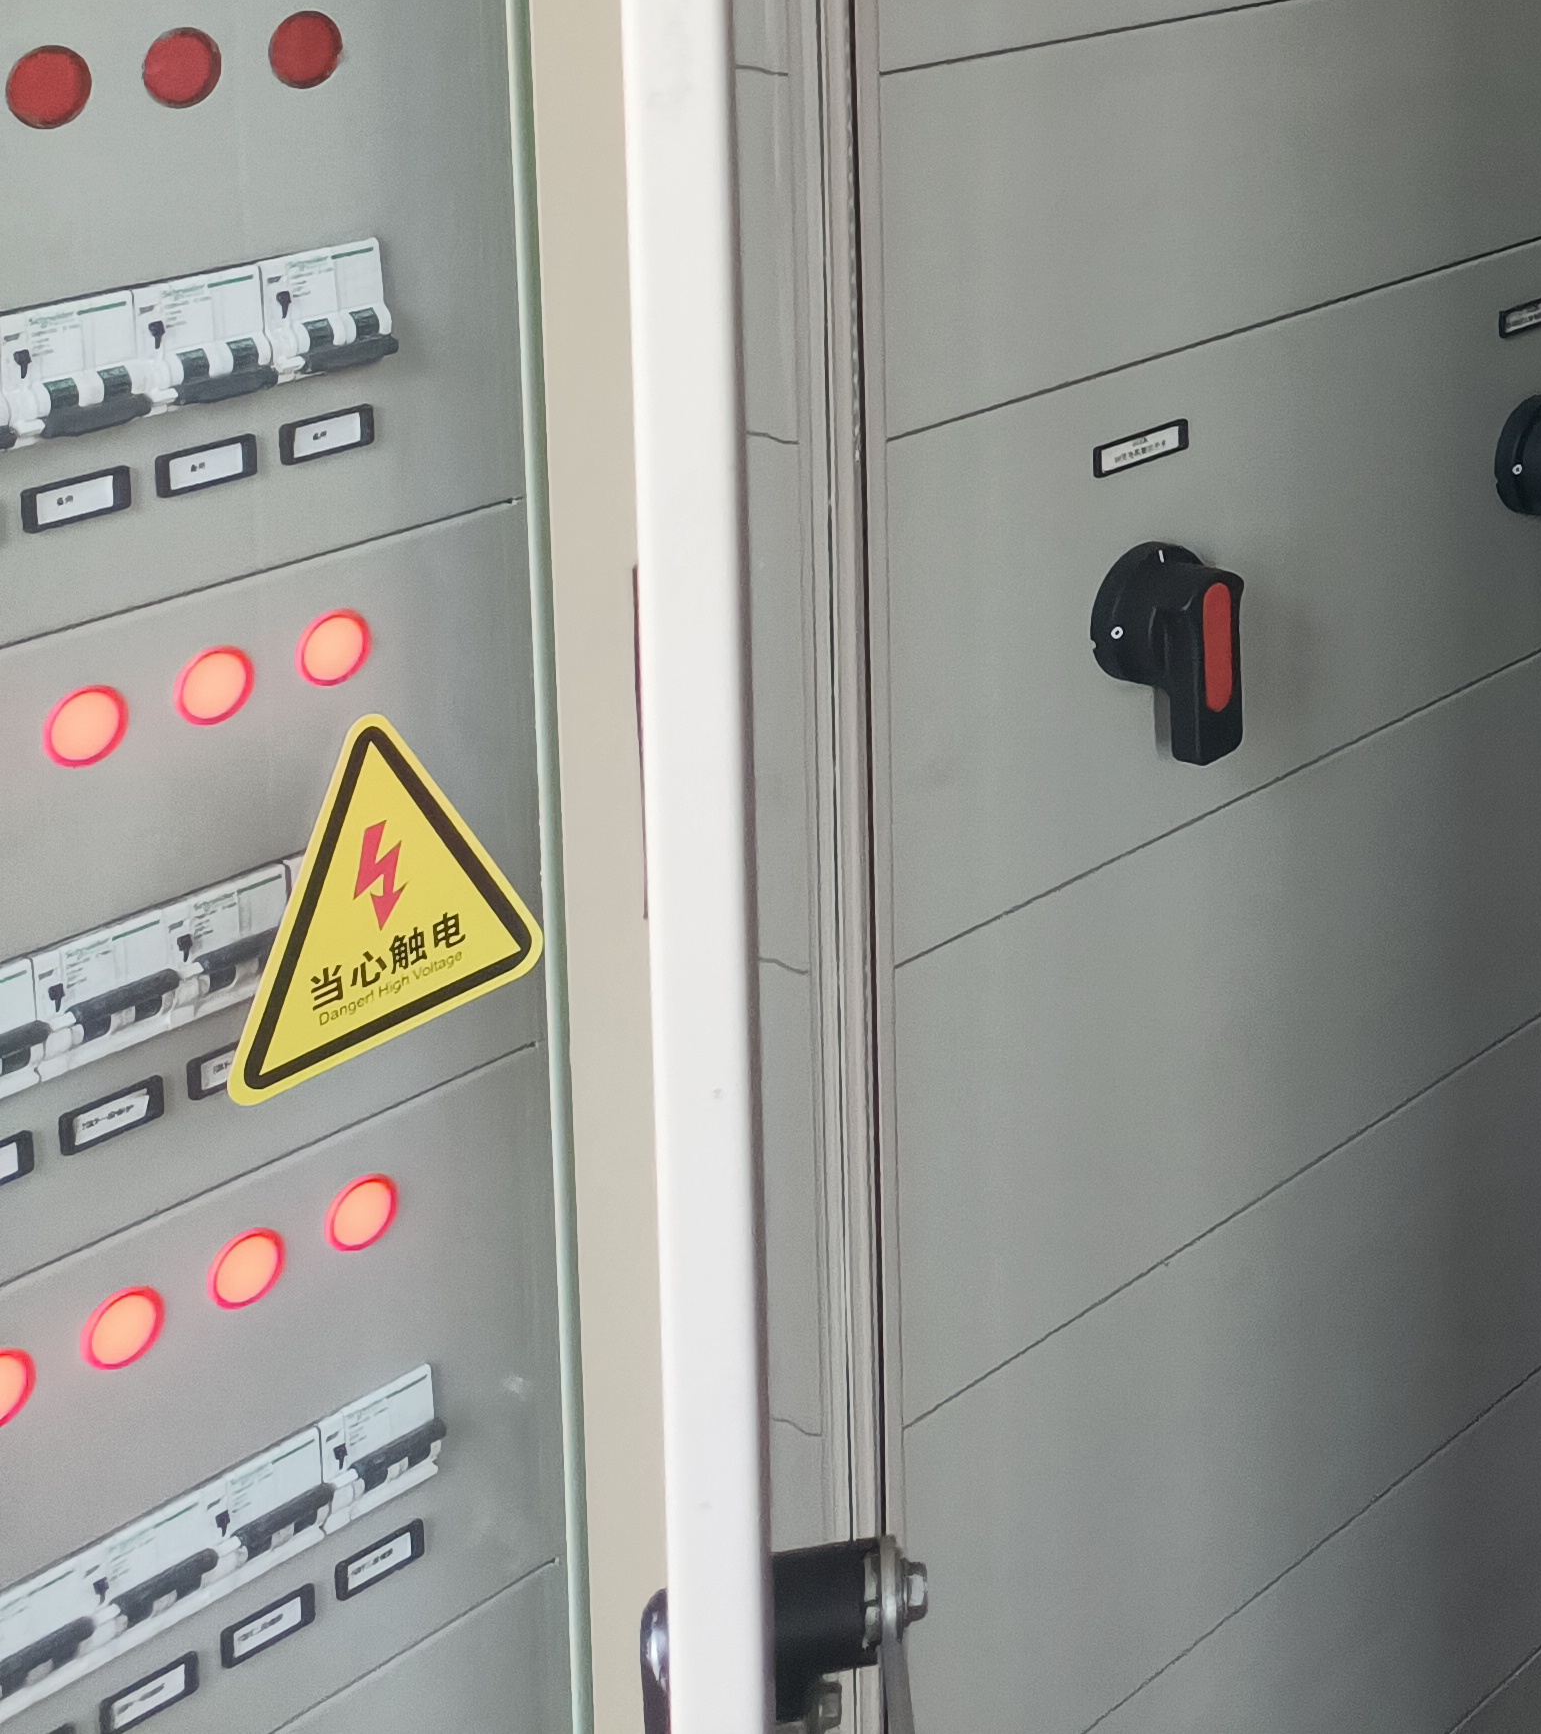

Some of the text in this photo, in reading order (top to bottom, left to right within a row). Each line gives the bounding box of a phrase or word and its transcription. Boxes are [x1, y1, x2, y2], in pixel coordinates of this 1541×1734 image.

[311, 912, 466, 1011] 当心触电
[378, 974, 411, 998] High
[412, 951, 464, 980] Voltage
